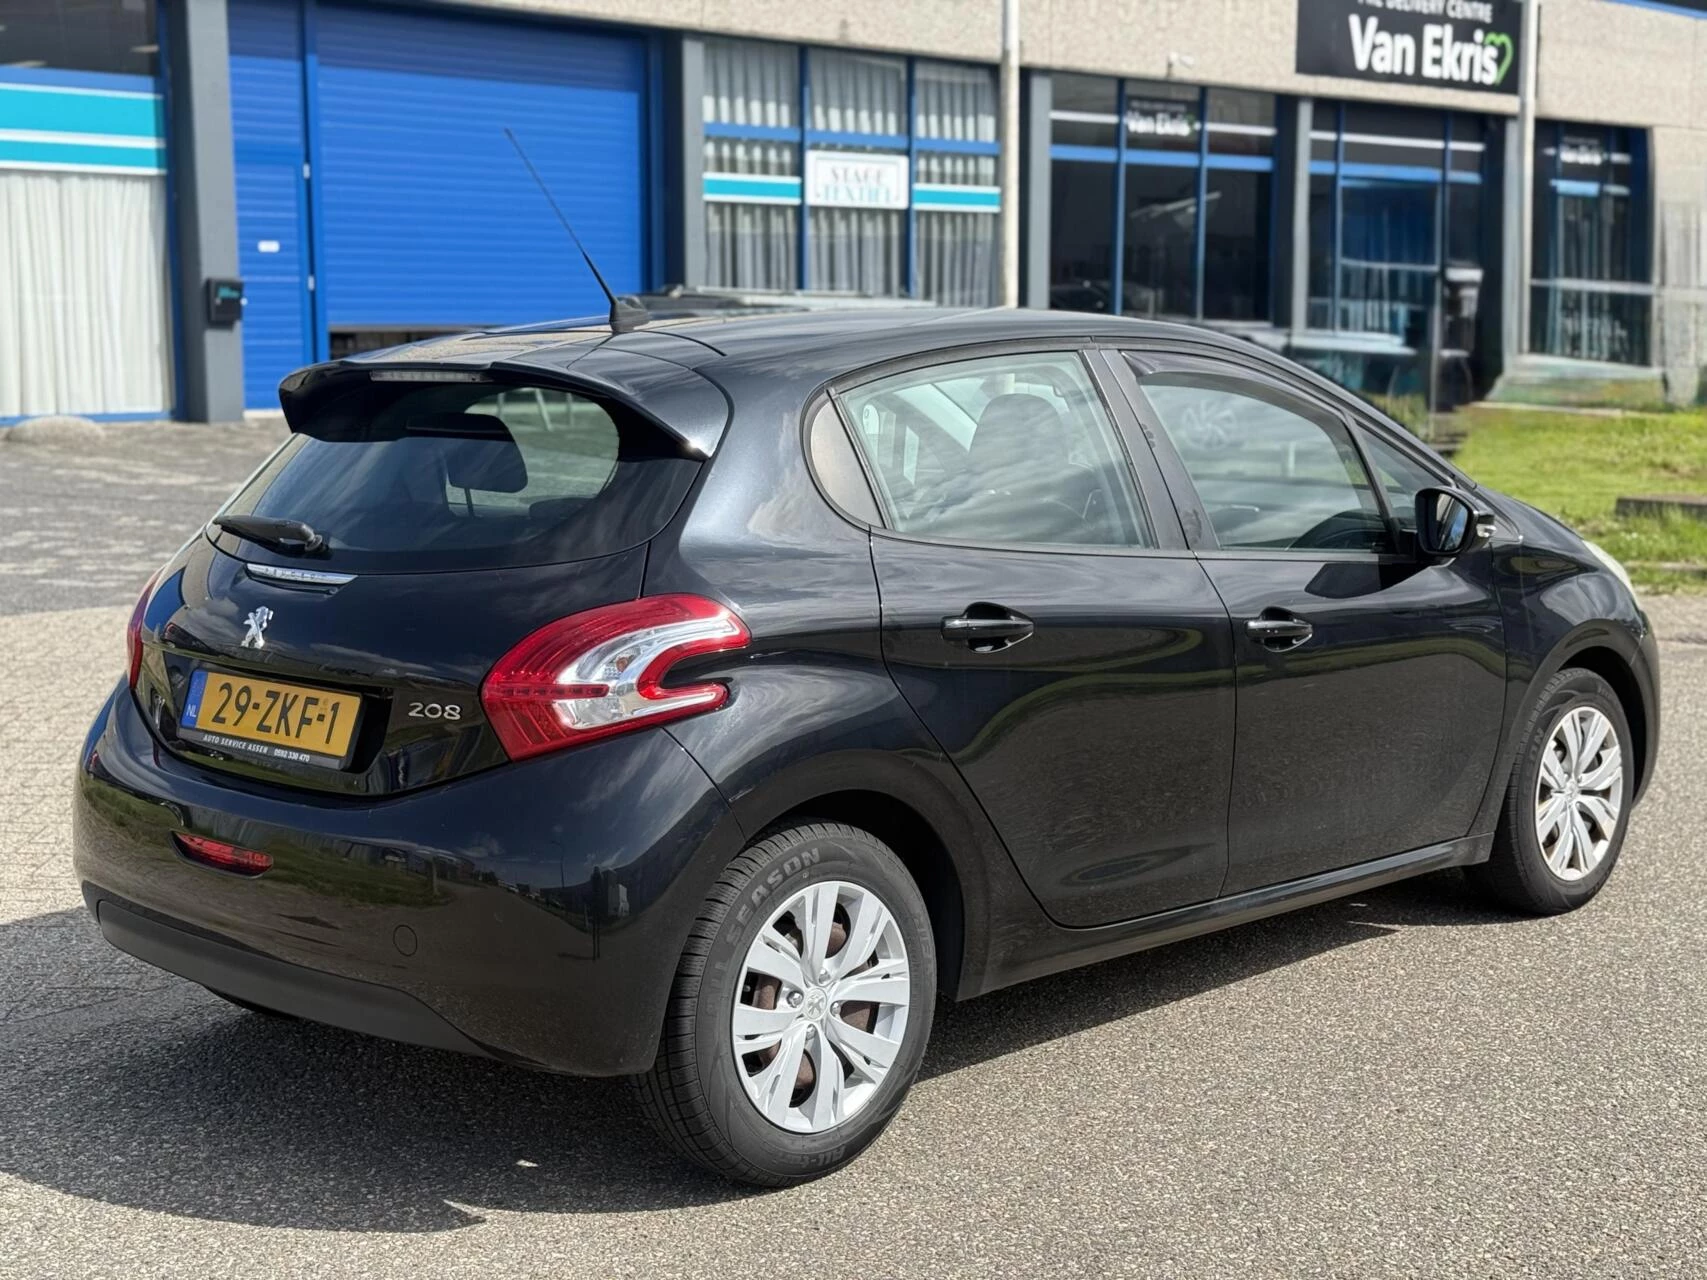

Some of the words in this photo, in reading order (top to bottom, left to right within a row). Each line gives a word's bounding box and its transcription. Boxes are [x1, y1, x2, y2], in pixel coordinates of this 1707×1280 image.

[1348, 13, 1416, 76] Van
[1421, 23, 1499, 85] Ekris
[186, 703, 197, 718] NL
[211, 682, 341, 745] 29-ZKF-1
[408, 702, 461, 720] 208
[203, 734, 220, 744] AUTO
[221, 737, 246, 749] SERVICE
[247, 743, 269, 754] ASSEN
[725, 848, 821, 947] SEASON
